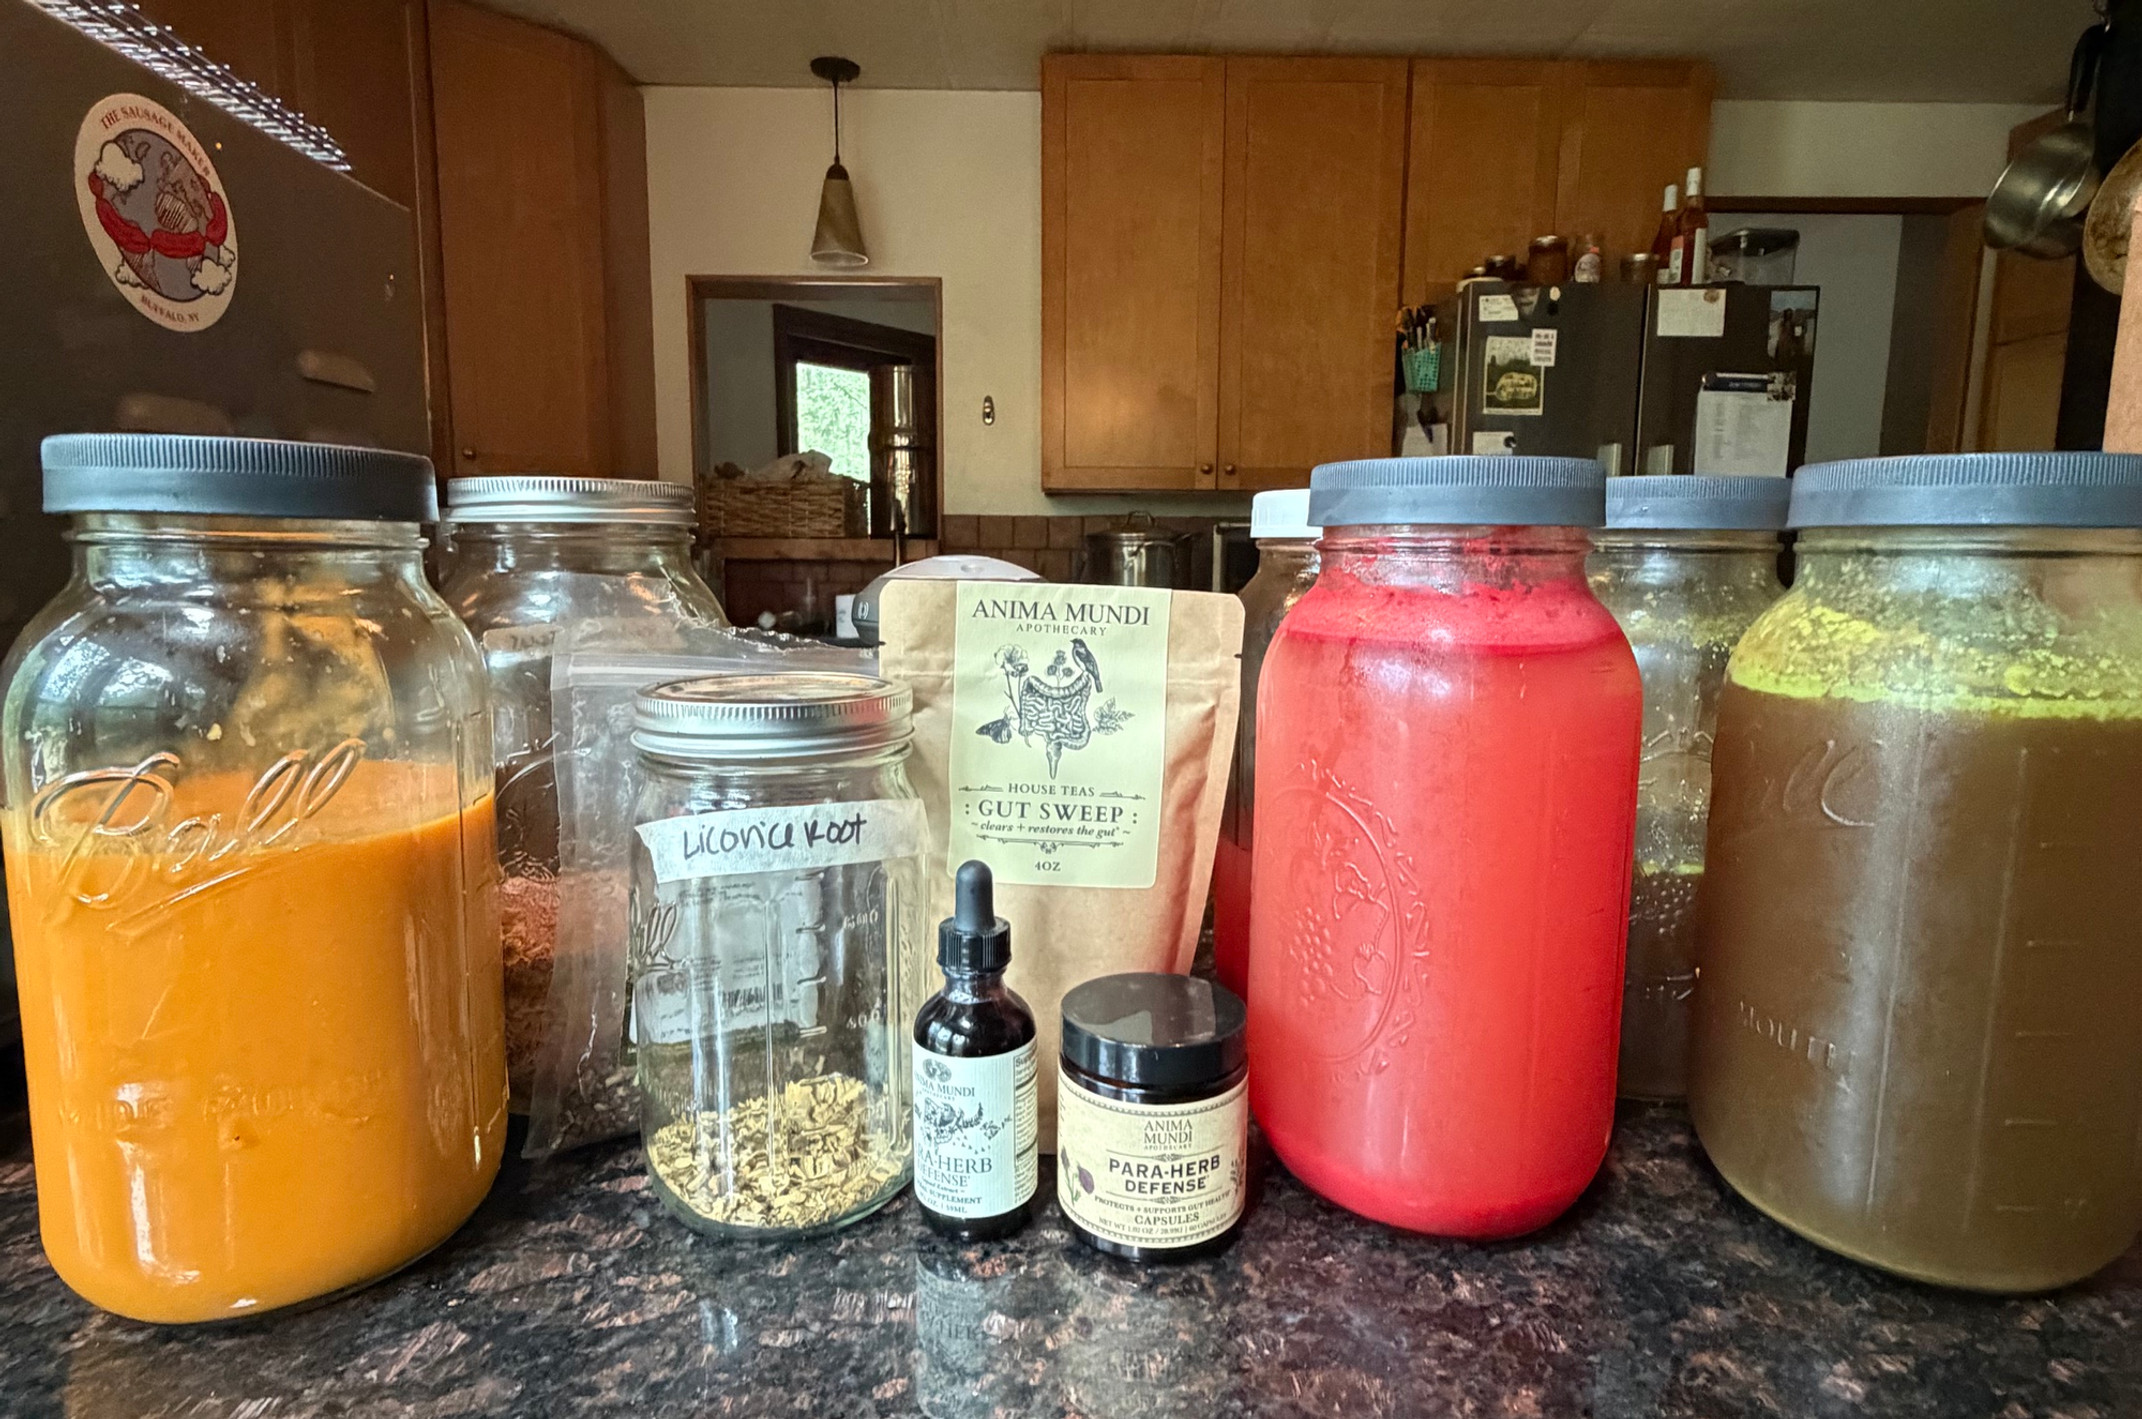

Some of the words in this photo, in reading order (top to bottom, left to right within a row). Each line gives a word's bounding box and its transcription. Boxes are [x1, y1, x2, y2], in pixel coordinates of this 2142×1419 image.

[100, 108, 121, 129] THE
[120, 106, 173, 133] SAUSAGE
[972, 599, 1057, 621] ANIMA
[1064, 602, 1150, 626] MUNDI
[1016, 623, 1107, 636] APOTHECARY
[1008, 783, 1057, 796] HOUSE
[1060, 785, 1096, 797] TEAS
[978, 799, 1032, 819] GUT
[1039, 802, 1124, 824] SWEEP
[31, 737, 368, 911] Ball
[980, 820, 1014, 833] clears
[1028, 825, 1074, 836] restores
[1076, 824, 1095, 837] the
[1034, 861, 1062, 872] 4OZ
[937, 1083, 976, 1098] MUNDI
[1144, 1119, 1193, 1132] ANIMA
[1143, 1130, 1193, 1144] MUNDI
[1109, 1154, 1221, 1180] PARA-HERB
[1094, 1194, 1135, 1213] PROTECTS
[1143, 1204, 1187, 1215] SUPPORTS
[1187, 1201, 1205, 1212] GUT
[1098, 1215, 1112, 1228] NET
[1113, 1221, 1126, 1231] WT
[1134, 1211, 1200, 1226] CAPSULES
